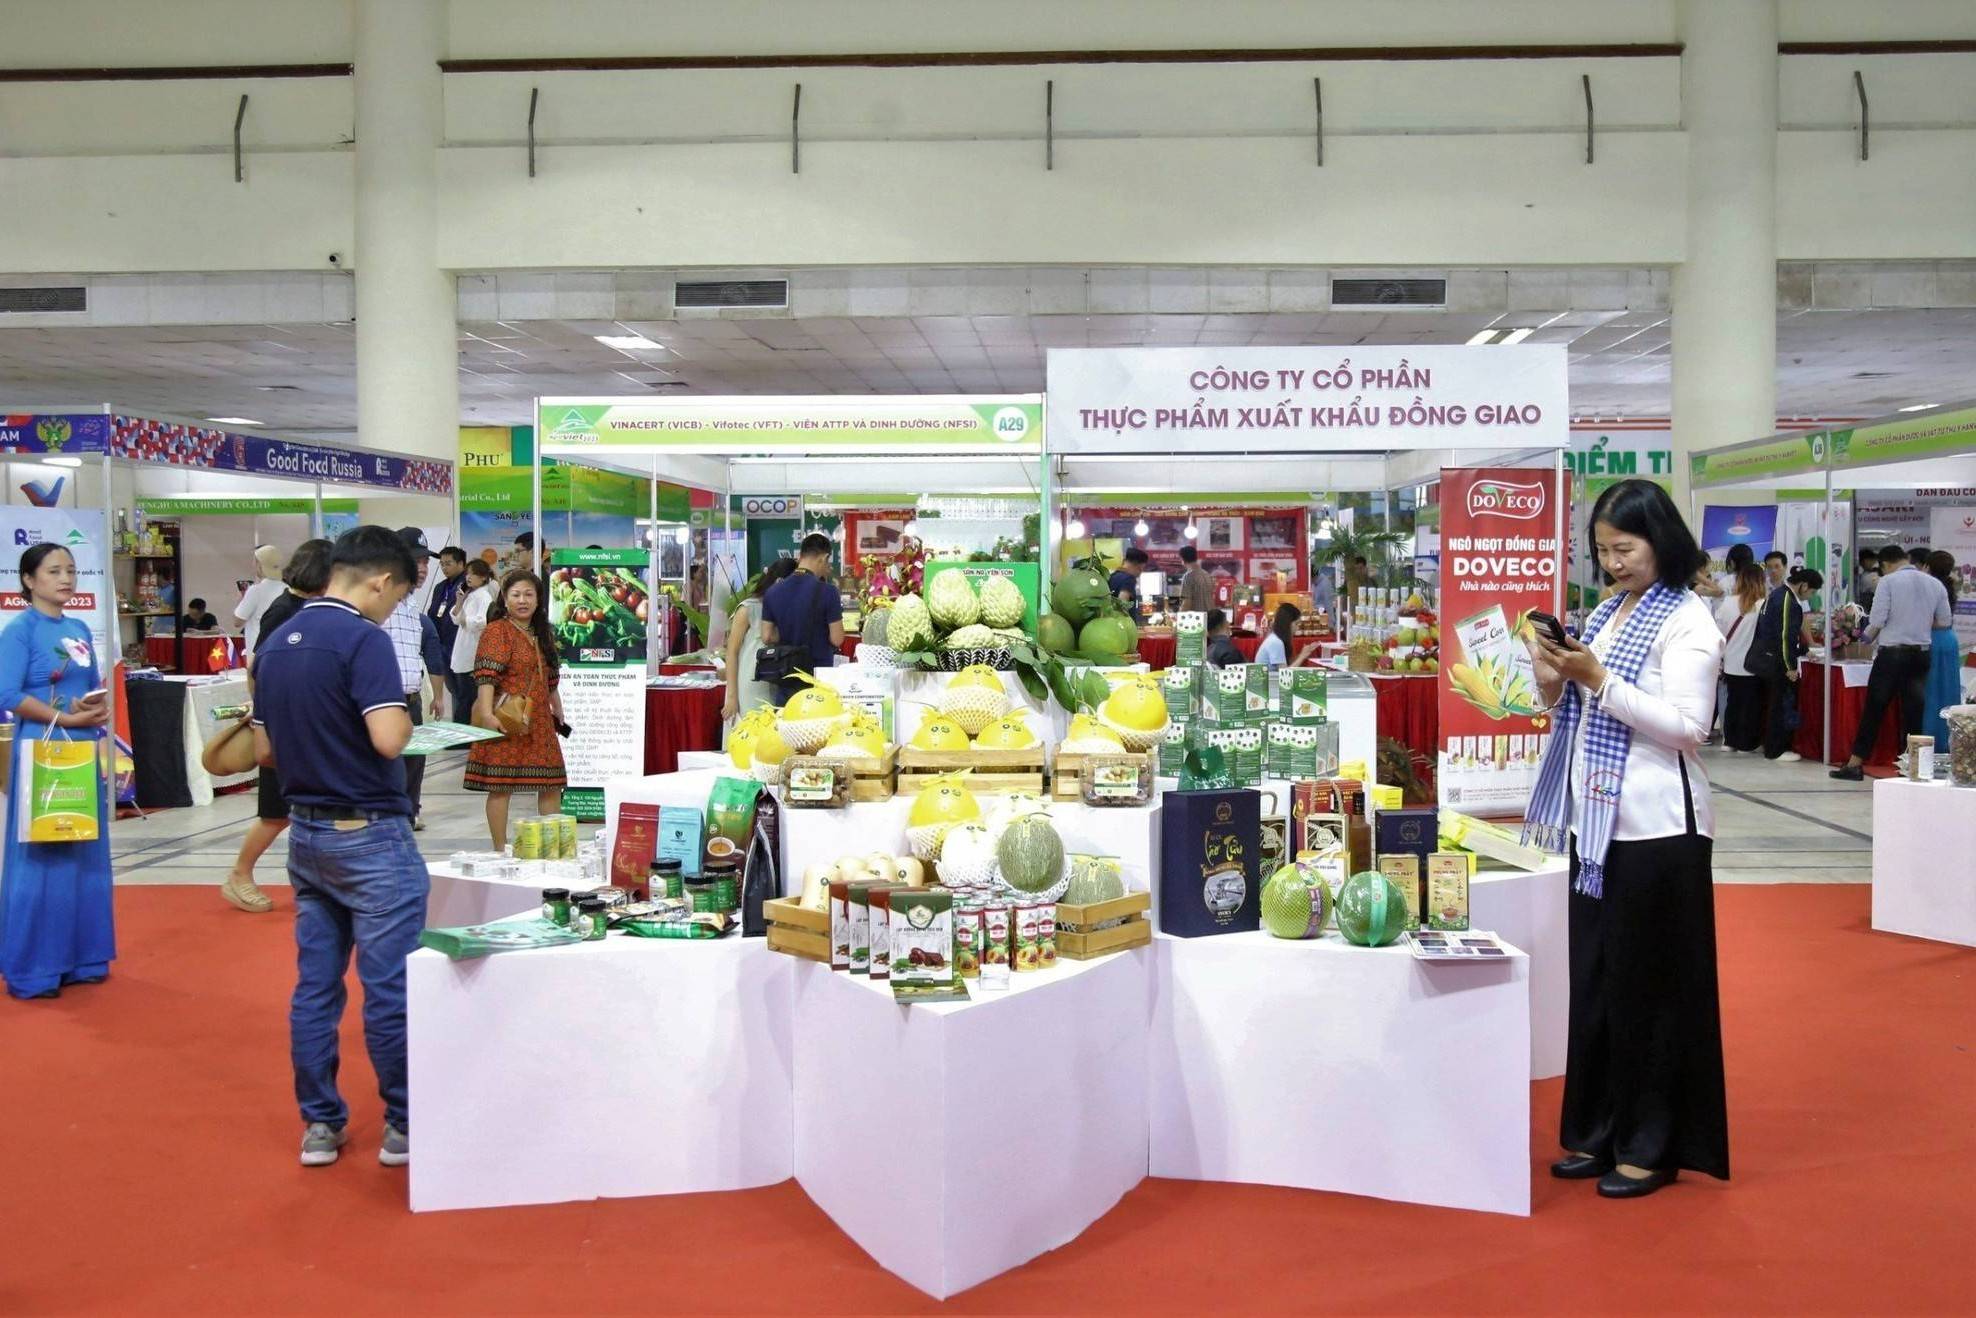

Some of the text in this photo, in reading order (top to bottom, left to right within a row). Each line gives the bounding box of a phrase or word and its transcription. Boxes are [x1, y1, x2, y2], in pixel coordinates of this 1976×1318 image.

[1190, 358, 1431, 391] CÔNG TY CỔ PHẦN
[1080, 395, 1542, 434] THỰC PHẨM XUẤT KHẨU ĐỒNG GIAO
[611, 420, 665, 431] VINACERT
[668, 420, 703, 431] (VICB)
[713, 419, 750, 430] Vifotec
[753, 419, 783, 430] (VFT)
[793, 417, 819, 430] VIỆN
[822, 420, 850, 430] ATTP
[852, 418, 868, 429] VÀ
[870, 420, 897, 429] DINH
[900, 417, 941, 429] DƯỠNG
[943, 420, 978, 430] (NFSI)
[999, 416, 1024, 432] A29
[267, 448, 299, 472] Good
[331, 459, 363, 479] Russia
[747, 499, 798, 514] OCOP
[1448, 536, 1472, 551] NGÔ
[1474, 538, 1503, 554] NGỌT
[1538, 538, 1563, 551] GIA
[1453, 556, 1556, 577] DOVECO
[1459, 580, 1550, 593] Nhà nào cũng thích
